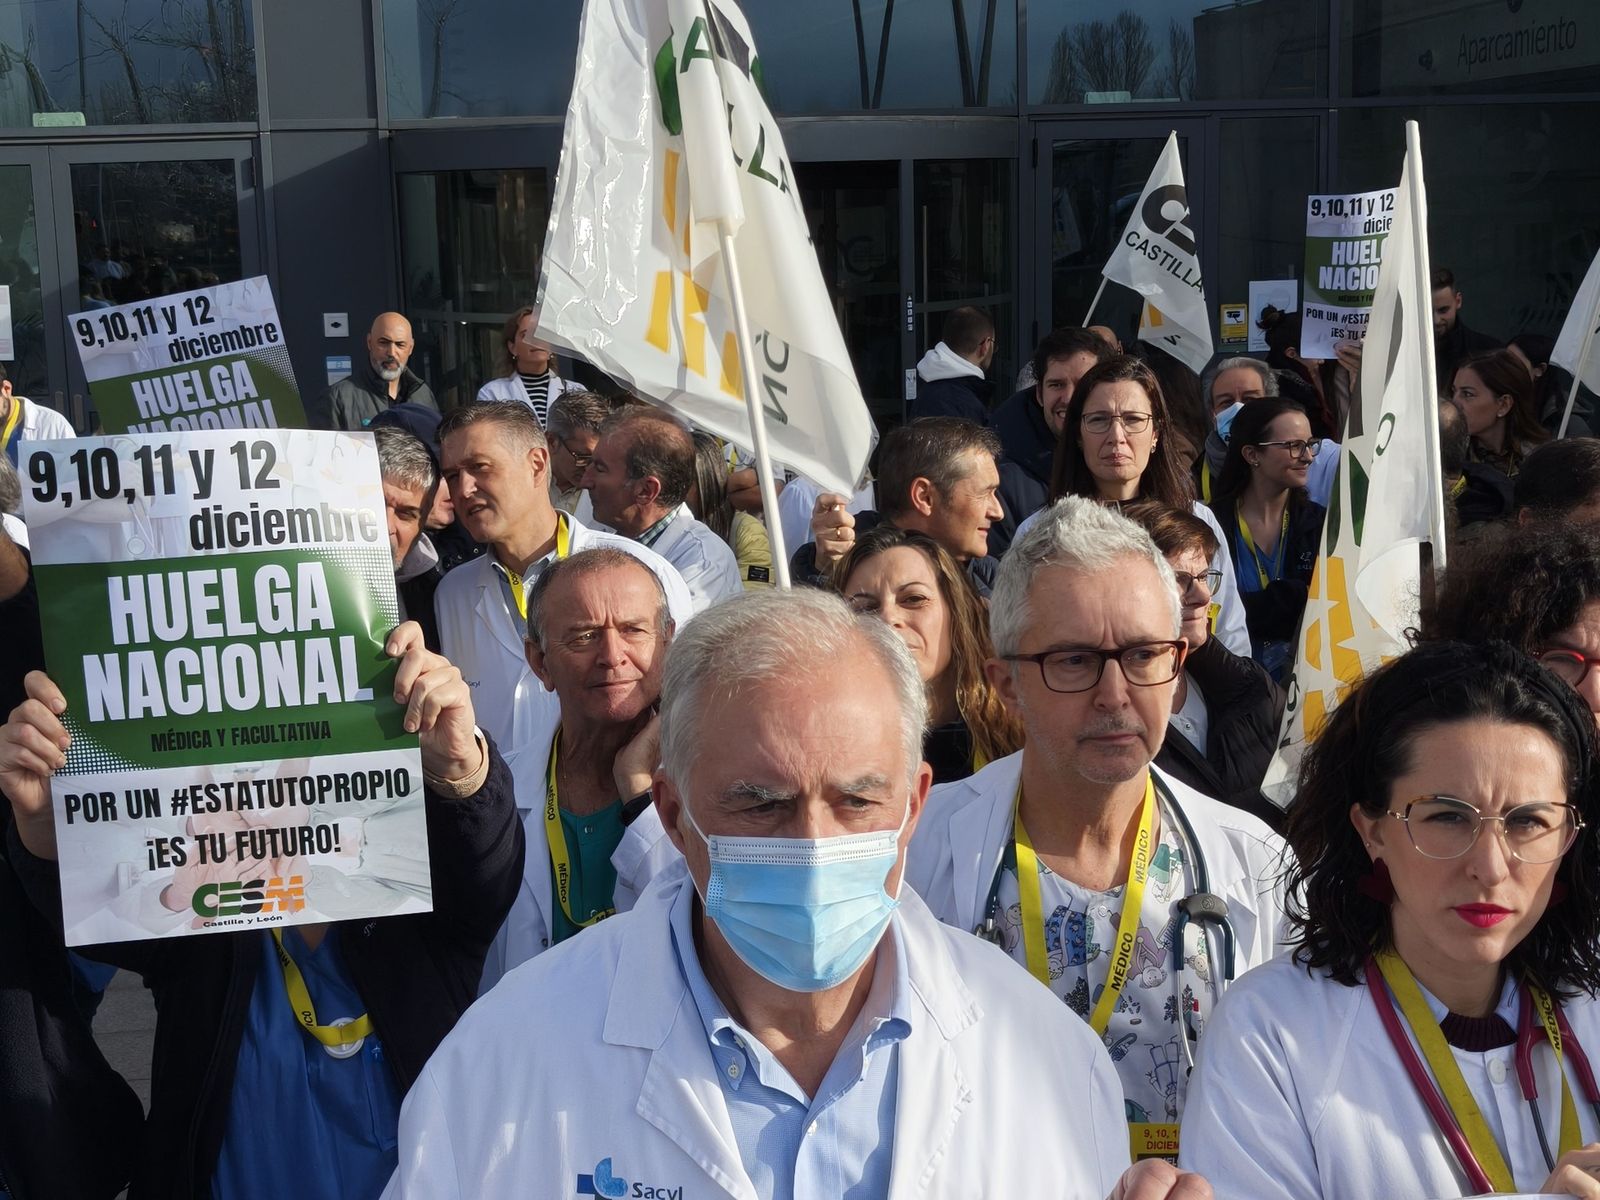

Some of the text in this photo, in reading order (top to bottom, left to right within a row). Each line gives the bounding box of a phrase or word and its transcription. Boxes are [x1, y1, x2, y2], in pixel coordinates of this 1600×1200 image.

[1456, 16, 1577, 73] Aparcamiento
[1311, 192, 1395, 220] 9,10,11 y 12
[1124, 231, 1204, 294] CASTILLA
[1331, 239, 1382, 266] HUEL
[1318, 265, 1379, 291] NACIO
[76, 295, 216, 349] 9,10,11 y 12
[1306, 308, 1370, 325] POR UN #ESTA
[1331, 327, 1345, 339] ¡ES
[1347, 330, 1359, 341] TU
[168, 320, 280, 363] diciembre
[131, 360, 260, 420] HUELGA
[28, 440, 281, 509] 9,10,11 y 12
[189, 502, 379, 552] diciembre
[107, 561, 336, 645] HUELGA
[82, 635, 375, 723] NACIONAL
[151, 720, 332, 753] MÉDICA Y FACULTATIVA
[64, 767, 411, 825] POR UN #ESTATUTOPROPIO
[147, 823, 342, 871] ¡ES TU FUTURO!
[1134, 829, 1150, 885] MÉDICO
[191, 875, 305, 918] CESM
[558, 863, 569, 904] MÉDICO
[202, 913, 283, 928] Castilla y León
[1110, 931, 1134, 992] MÉDICO
[1155, 1128, 1170, 1139] 10,
[631, 1182, 683, 1200] Sacyl
